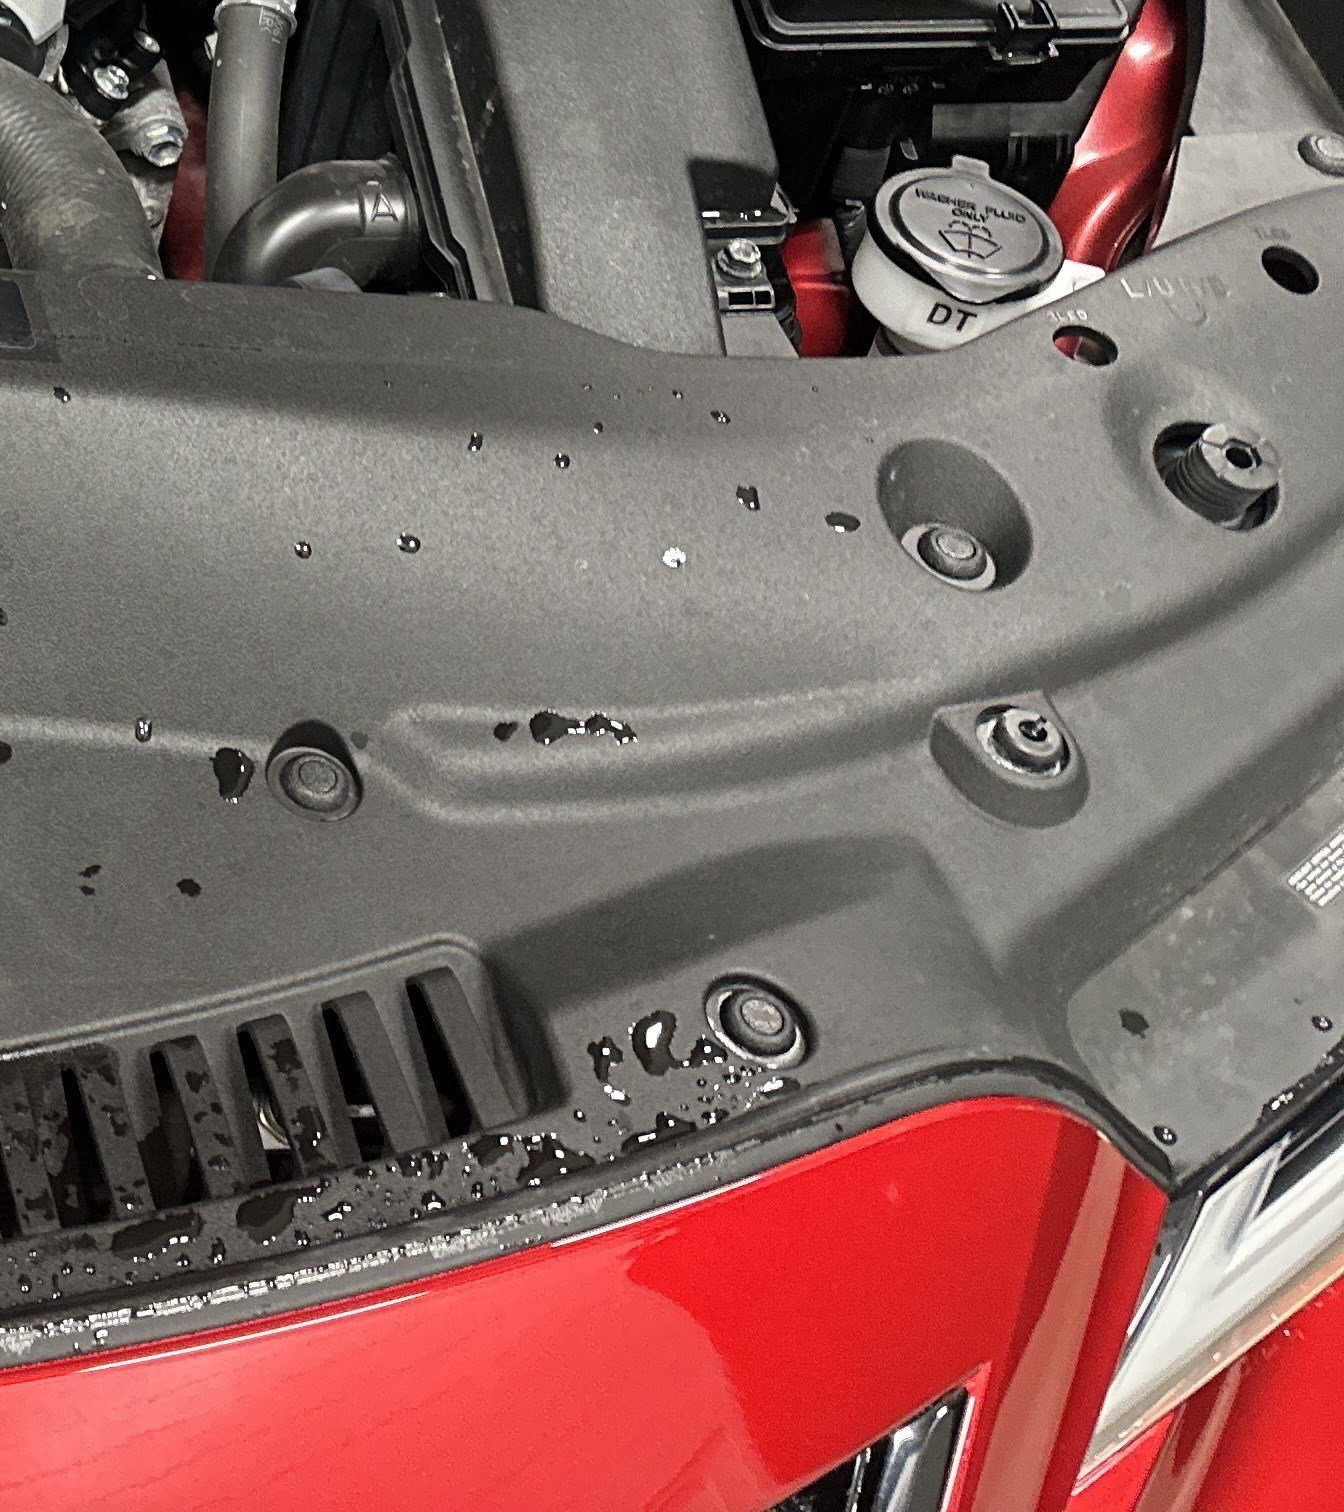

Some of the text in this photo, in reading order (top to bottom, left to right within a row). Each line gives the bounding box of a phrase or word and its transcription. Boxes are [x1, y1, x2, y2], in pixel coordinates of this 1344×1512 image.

[951, 207, 988, 224] ONLY
[985, 205, 1027, 224] FLUID
[926, 301, 978, 333] DT
